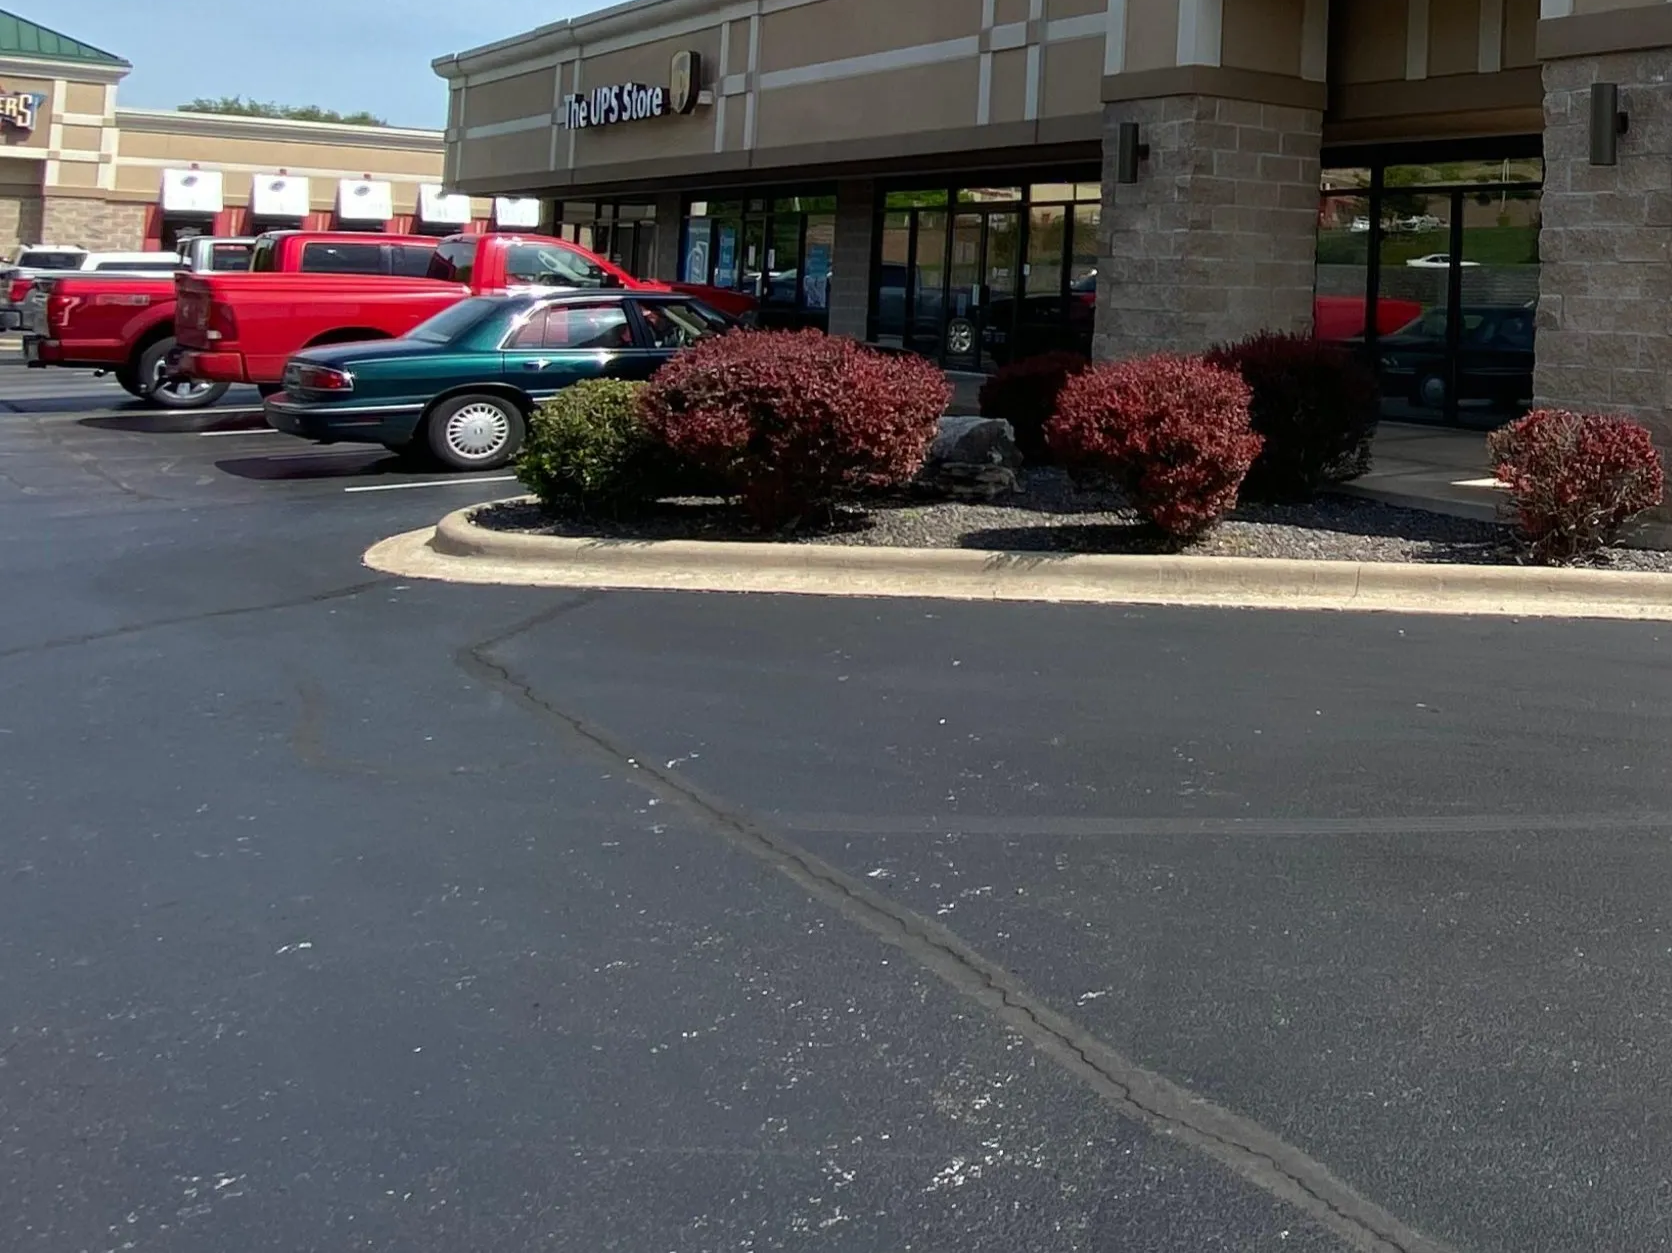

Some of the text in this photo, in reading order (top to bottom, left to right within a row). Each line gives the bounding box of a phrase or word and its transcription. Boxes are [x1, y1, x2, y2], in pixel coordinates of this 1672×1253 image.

[564, 93, 587, 130] The
[590, 84, 619, 126] UPS
[622, 81, 663, 121] Store
